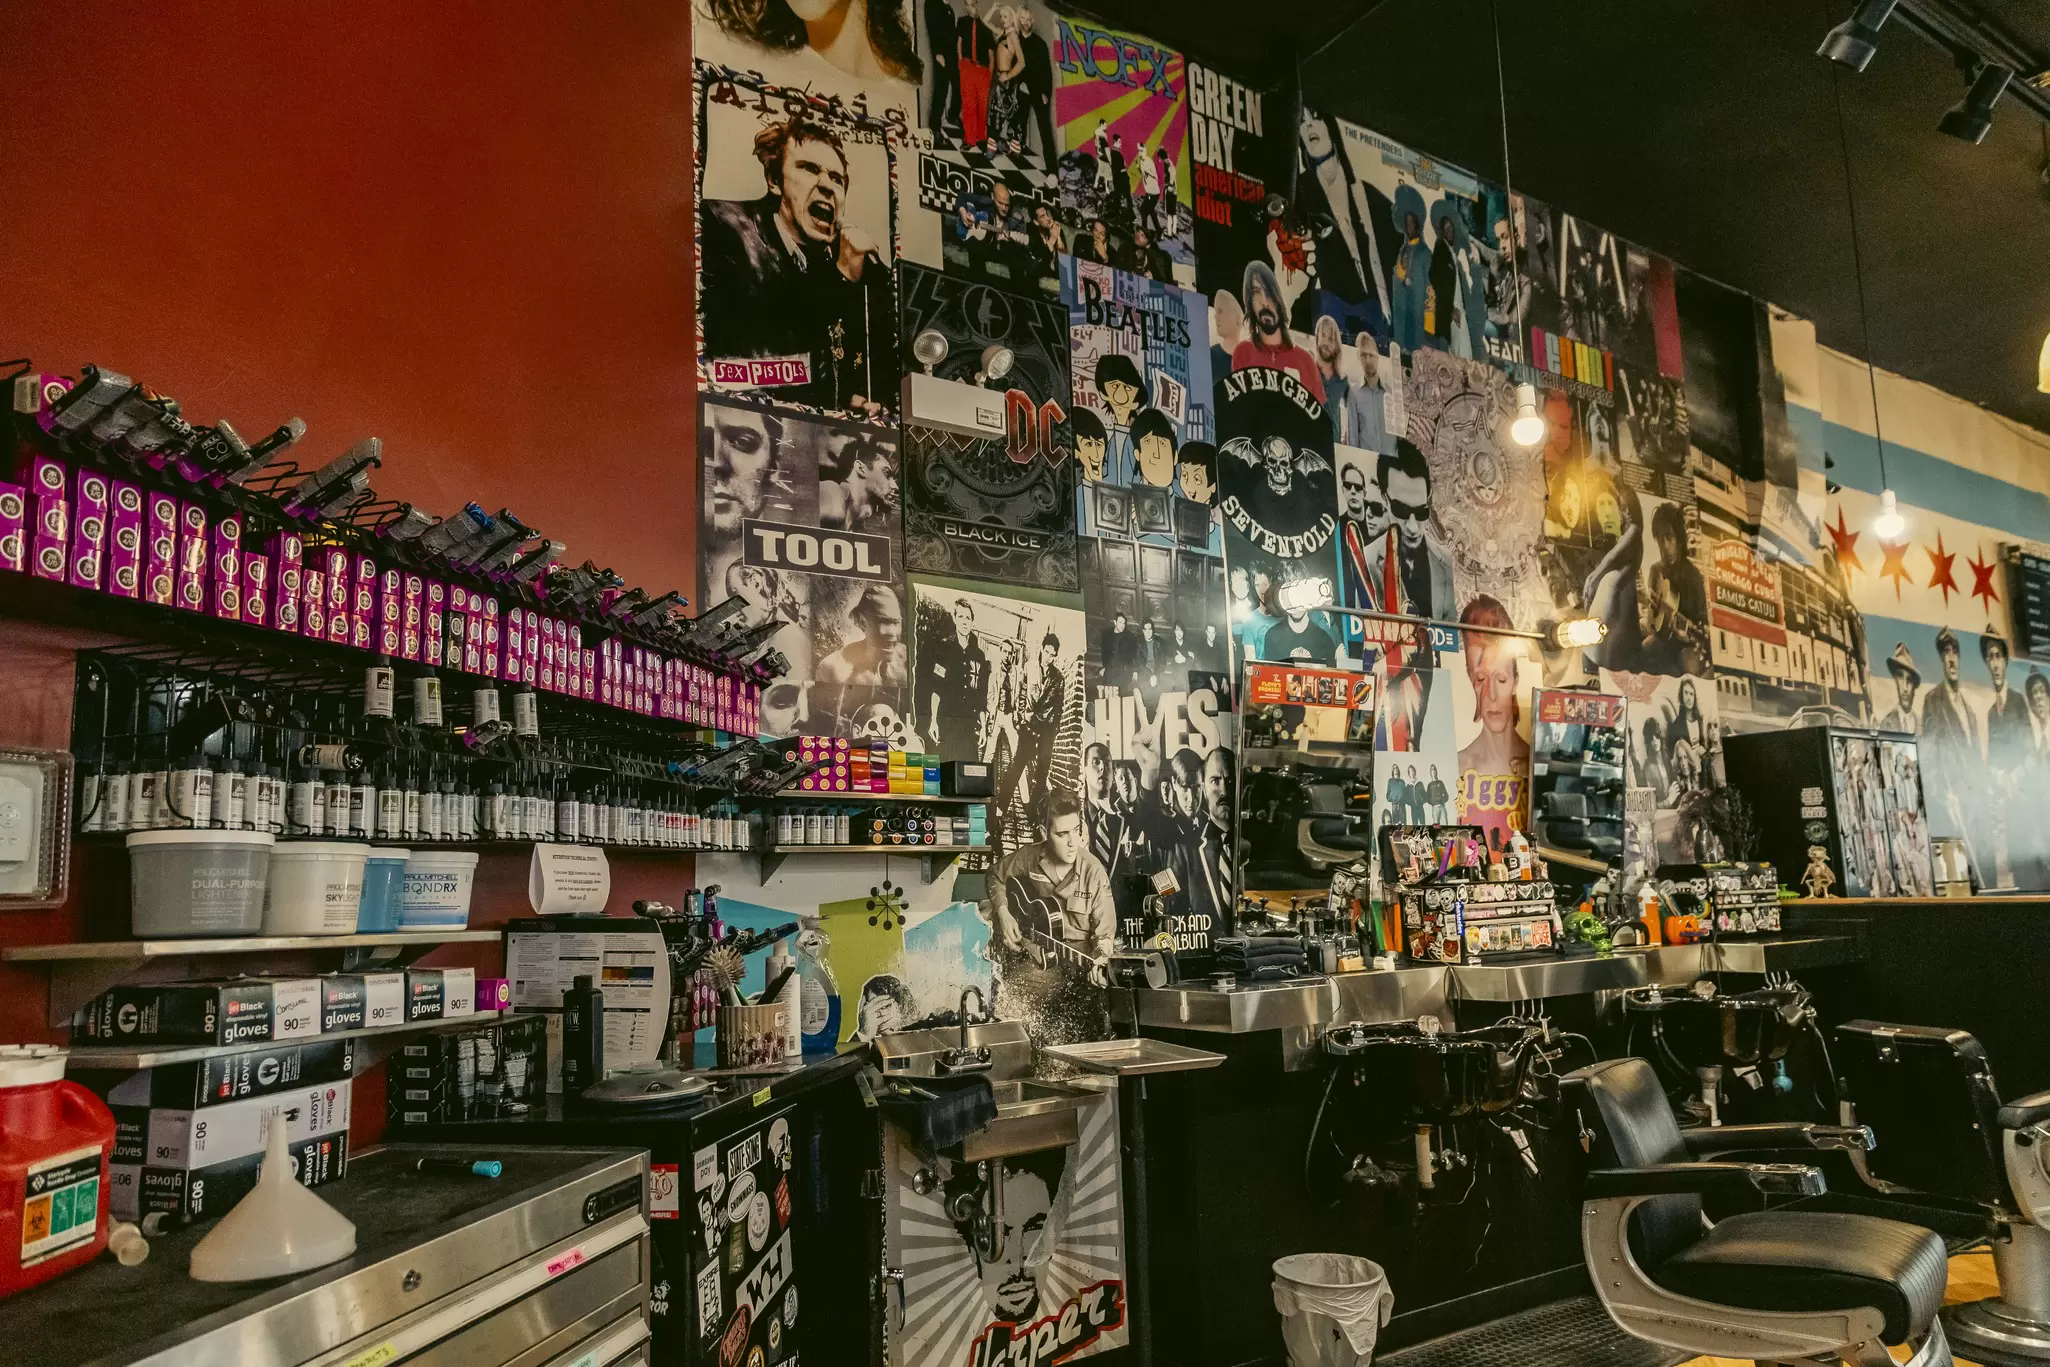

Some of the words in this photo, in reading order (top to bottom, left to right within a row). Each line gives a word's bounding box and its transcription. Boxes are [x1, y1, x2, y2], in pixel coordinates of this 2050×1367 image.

[1058, 19, 1178, 100] NOFX
[1188, 62, 1263, 137] GREEN
[1191, 112, 1236, 172] DAY
[1344, 126, 1358, 141] THE
[1359, 132, 1403, 158] PRETENDERS
[1194, 163, 1265, 205] american
[1196, 187, 1233, 228] idiot
[1083, 277, 1191, 351] BEATLES
[1223, 367, 1322, 420] AVENGED
[944, 523, 1008, 545] BLACK
[1011, 532, 1041, 549] ICE
[1222, 495, 1336, 559] SEVENFOLD
[752, 527, 882, 574] TOOL
[1717, 567, 1752, 590] CHICAGO
[1716, 586, 1746, 608] EAMUS
[1364, 618, 1417, 644] WHO
[1427, 626, 1454, 646] ODE
[1096, 685, 1120, 699] THE
[1095, 688, 1221, 761] HIVES
[1467, 773, 1522, 806] Iggy
[1123, 917, 1145, 936] THE
[1188, 914, 1212, 933] AND
[1174, 931, 1209, 951] LBUM
[240, 1001, 264, 1012] Black
[338, 991, 358, 1001] Black
[451, 999, 461, 1010] 90
[102, 993, 115, 1039] gloves
[326, 1009, 361, 1028] gloves
[372, 1007, 384, 1019] 90
[412, 1003, 441, 1018] gloves
[205, 1014, 216, 1033] 90
[225, 1023, 268, 1043] gloves
[284, 1018, 299, 1031] 90
[343, 1055, 352, 1072] 90
[310, 1091, 321, 1131] gloves
[326, 1101, 334, 1125] Black
[195, 1121, 207, 1139] 90
[156, 1147, 169, 1159] 90
[303, 1145, 316, 1186] gloves
[321, 1154, 330, 1181] Black
[700, 1166, 711, 1180] pay
[118, 1174, 132, 1186] 90
[145, 1173, 182, 1190] gloves
[192, 1180, 204, 1199] 90
